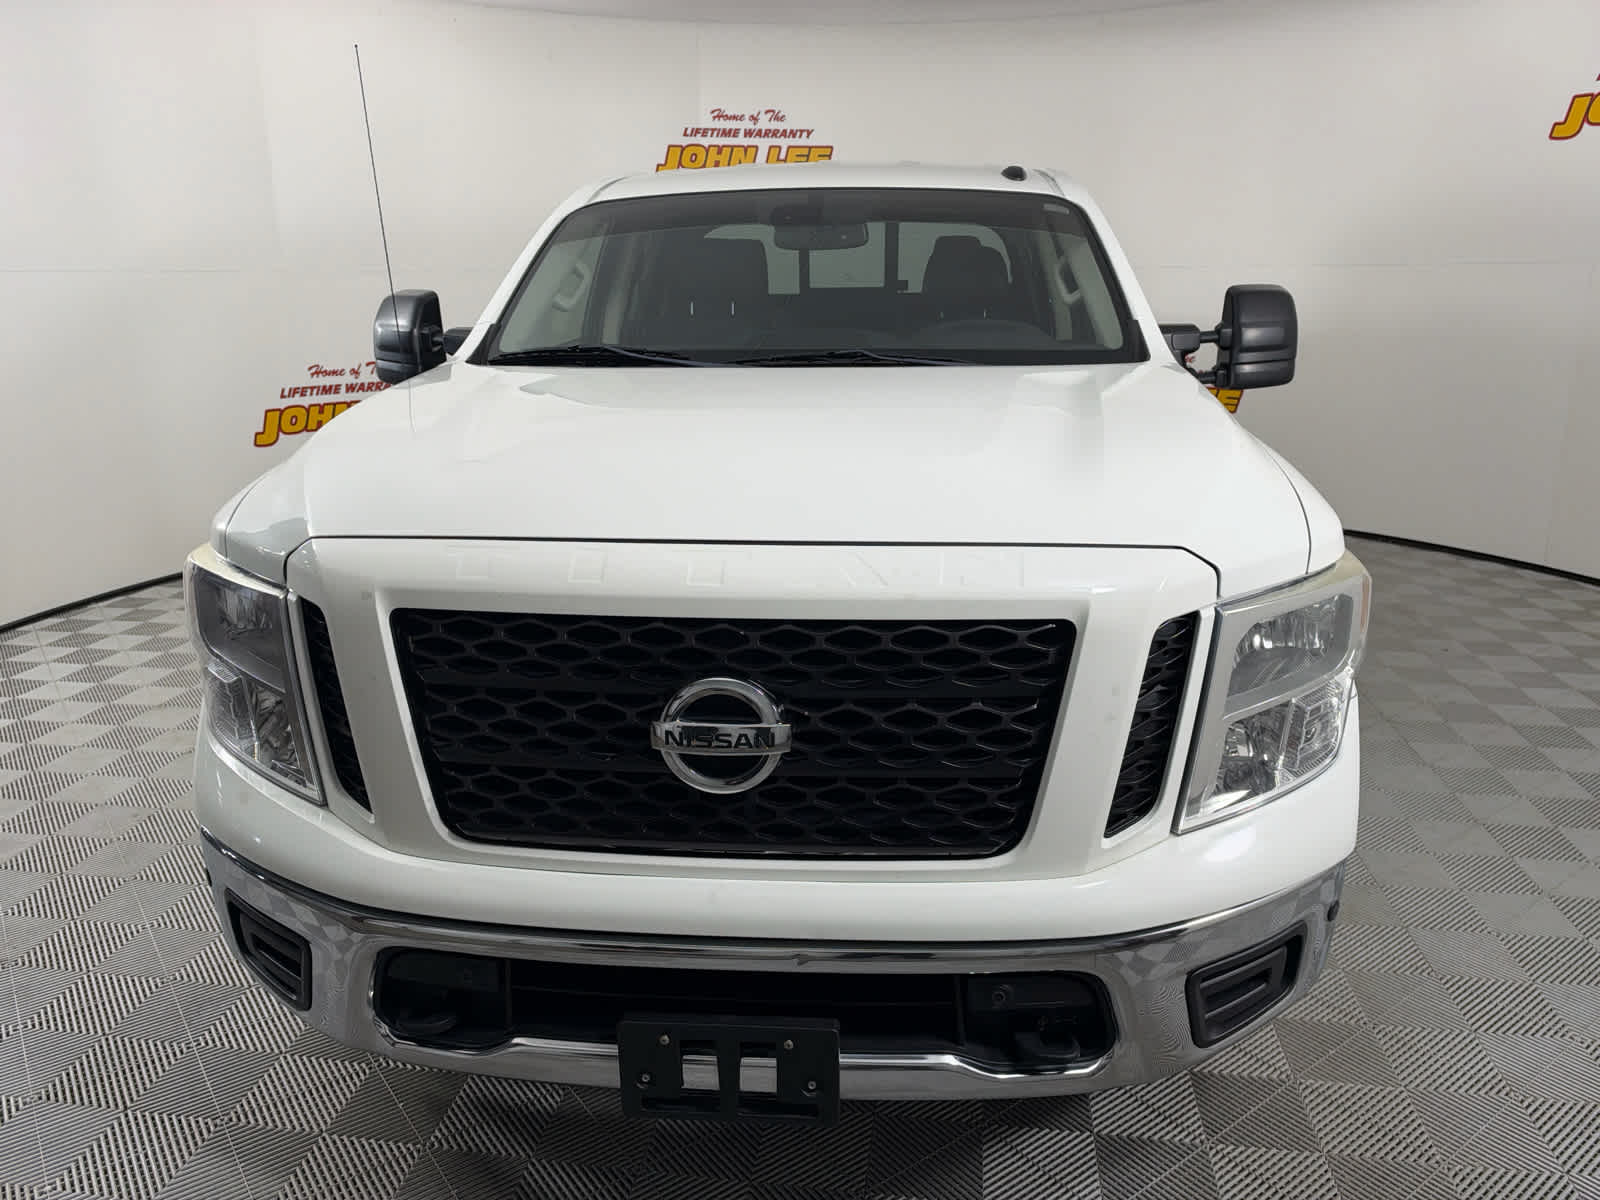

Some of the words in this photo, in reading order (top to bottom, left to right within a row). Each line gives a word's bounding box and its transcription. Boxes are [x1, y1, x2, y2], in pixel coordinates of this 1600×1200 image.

[710, 108, 745, 122] Home
[749, 111, 760, 126] of
[764, 109, 786, 122] The
[682, 127, 740, 138] LIFETIME
[743, 128, 814, 139] WARRANTY
[655, 144, 758, 172] JOHN
[308, 364, 346, 378] Home
[349, 363, 361, 379] of
[280, 384, 342, 399] LIFETIME
[664, 727, 775, 749] NISSAN
